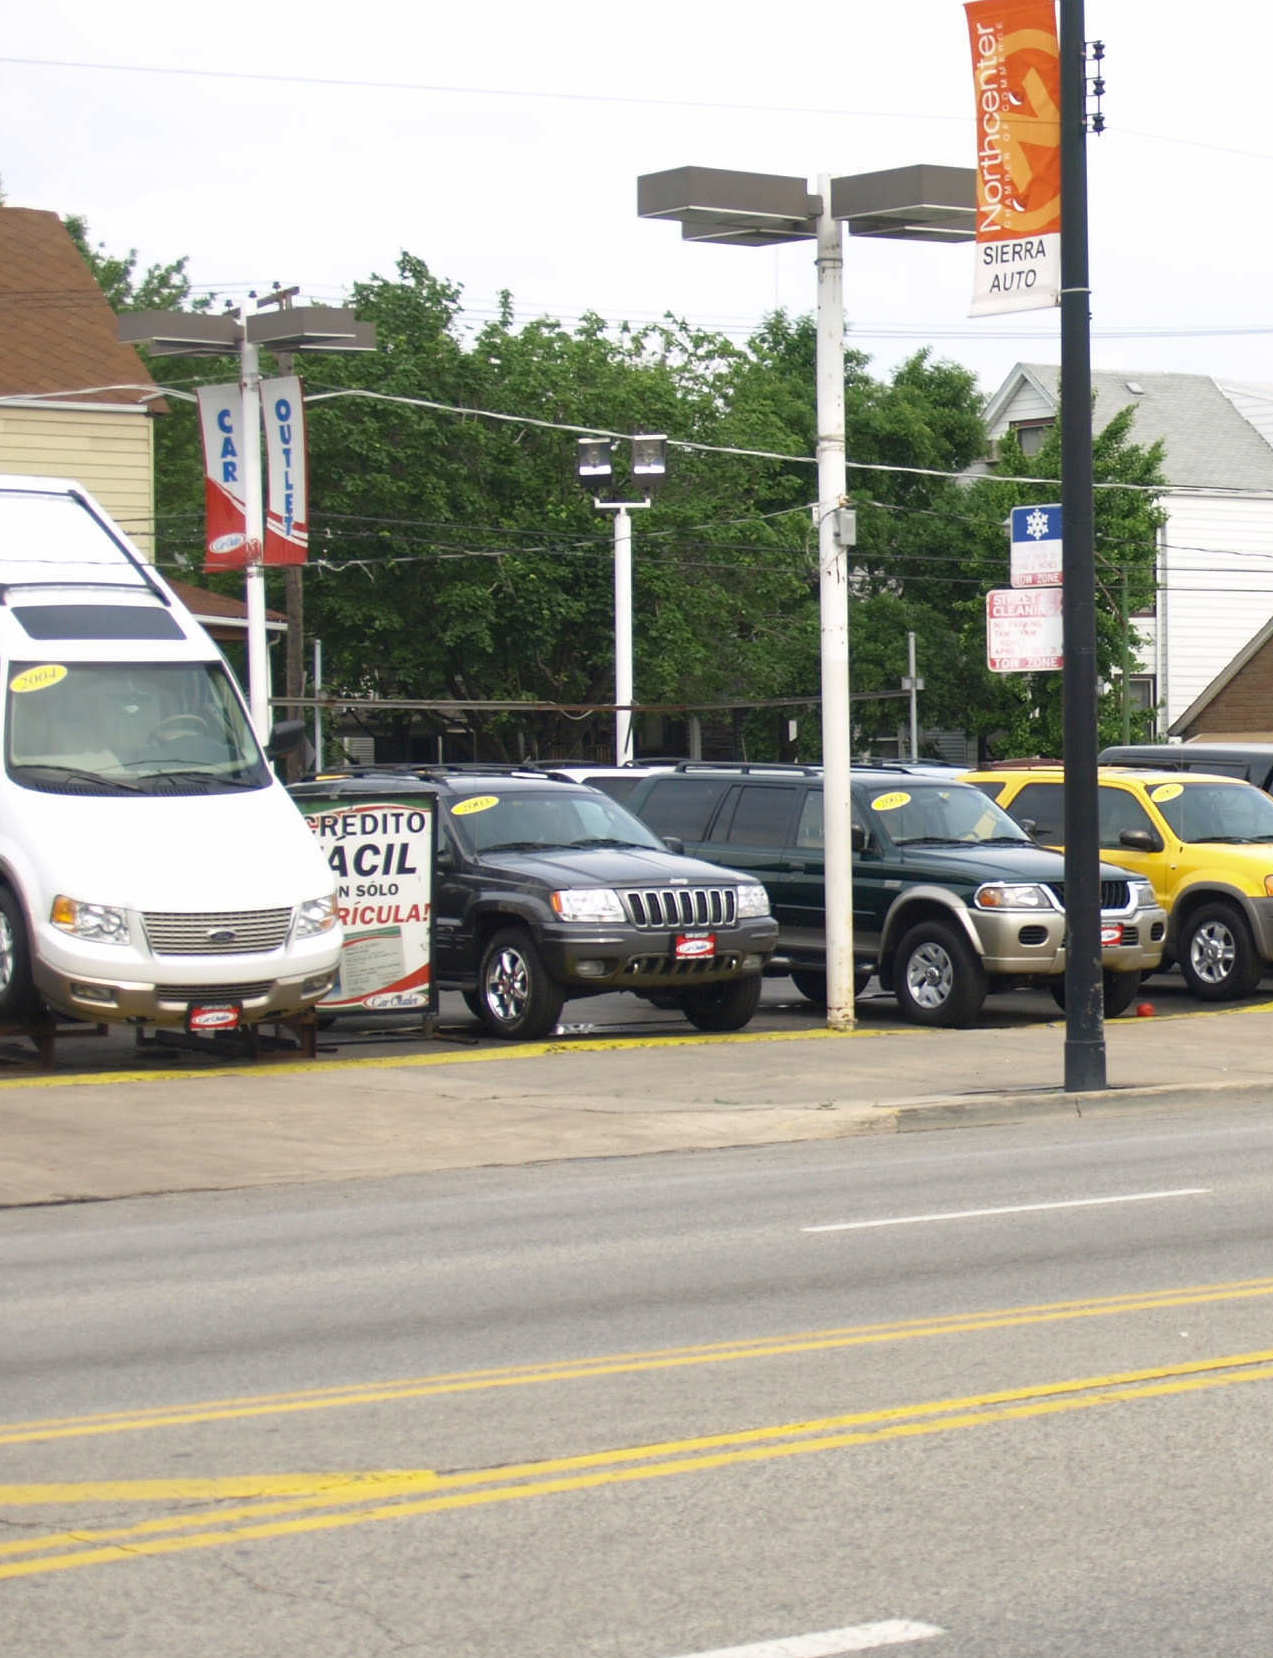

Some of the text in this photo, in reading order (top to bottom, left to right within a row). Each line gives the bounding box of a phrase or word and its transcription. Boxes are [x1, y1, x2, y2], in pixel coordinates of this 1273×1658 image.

[976, 22, 1003, 232] Northcenter
[983, 239, 1046, 266] SIERRA
[989, 269, 1037, 293] AUTO
[217, 398, 294, 536] CAR OUTLET
[321, 835, 417, 877] ÁCIL
[337, 901, 431, 926] RÍCULA!
